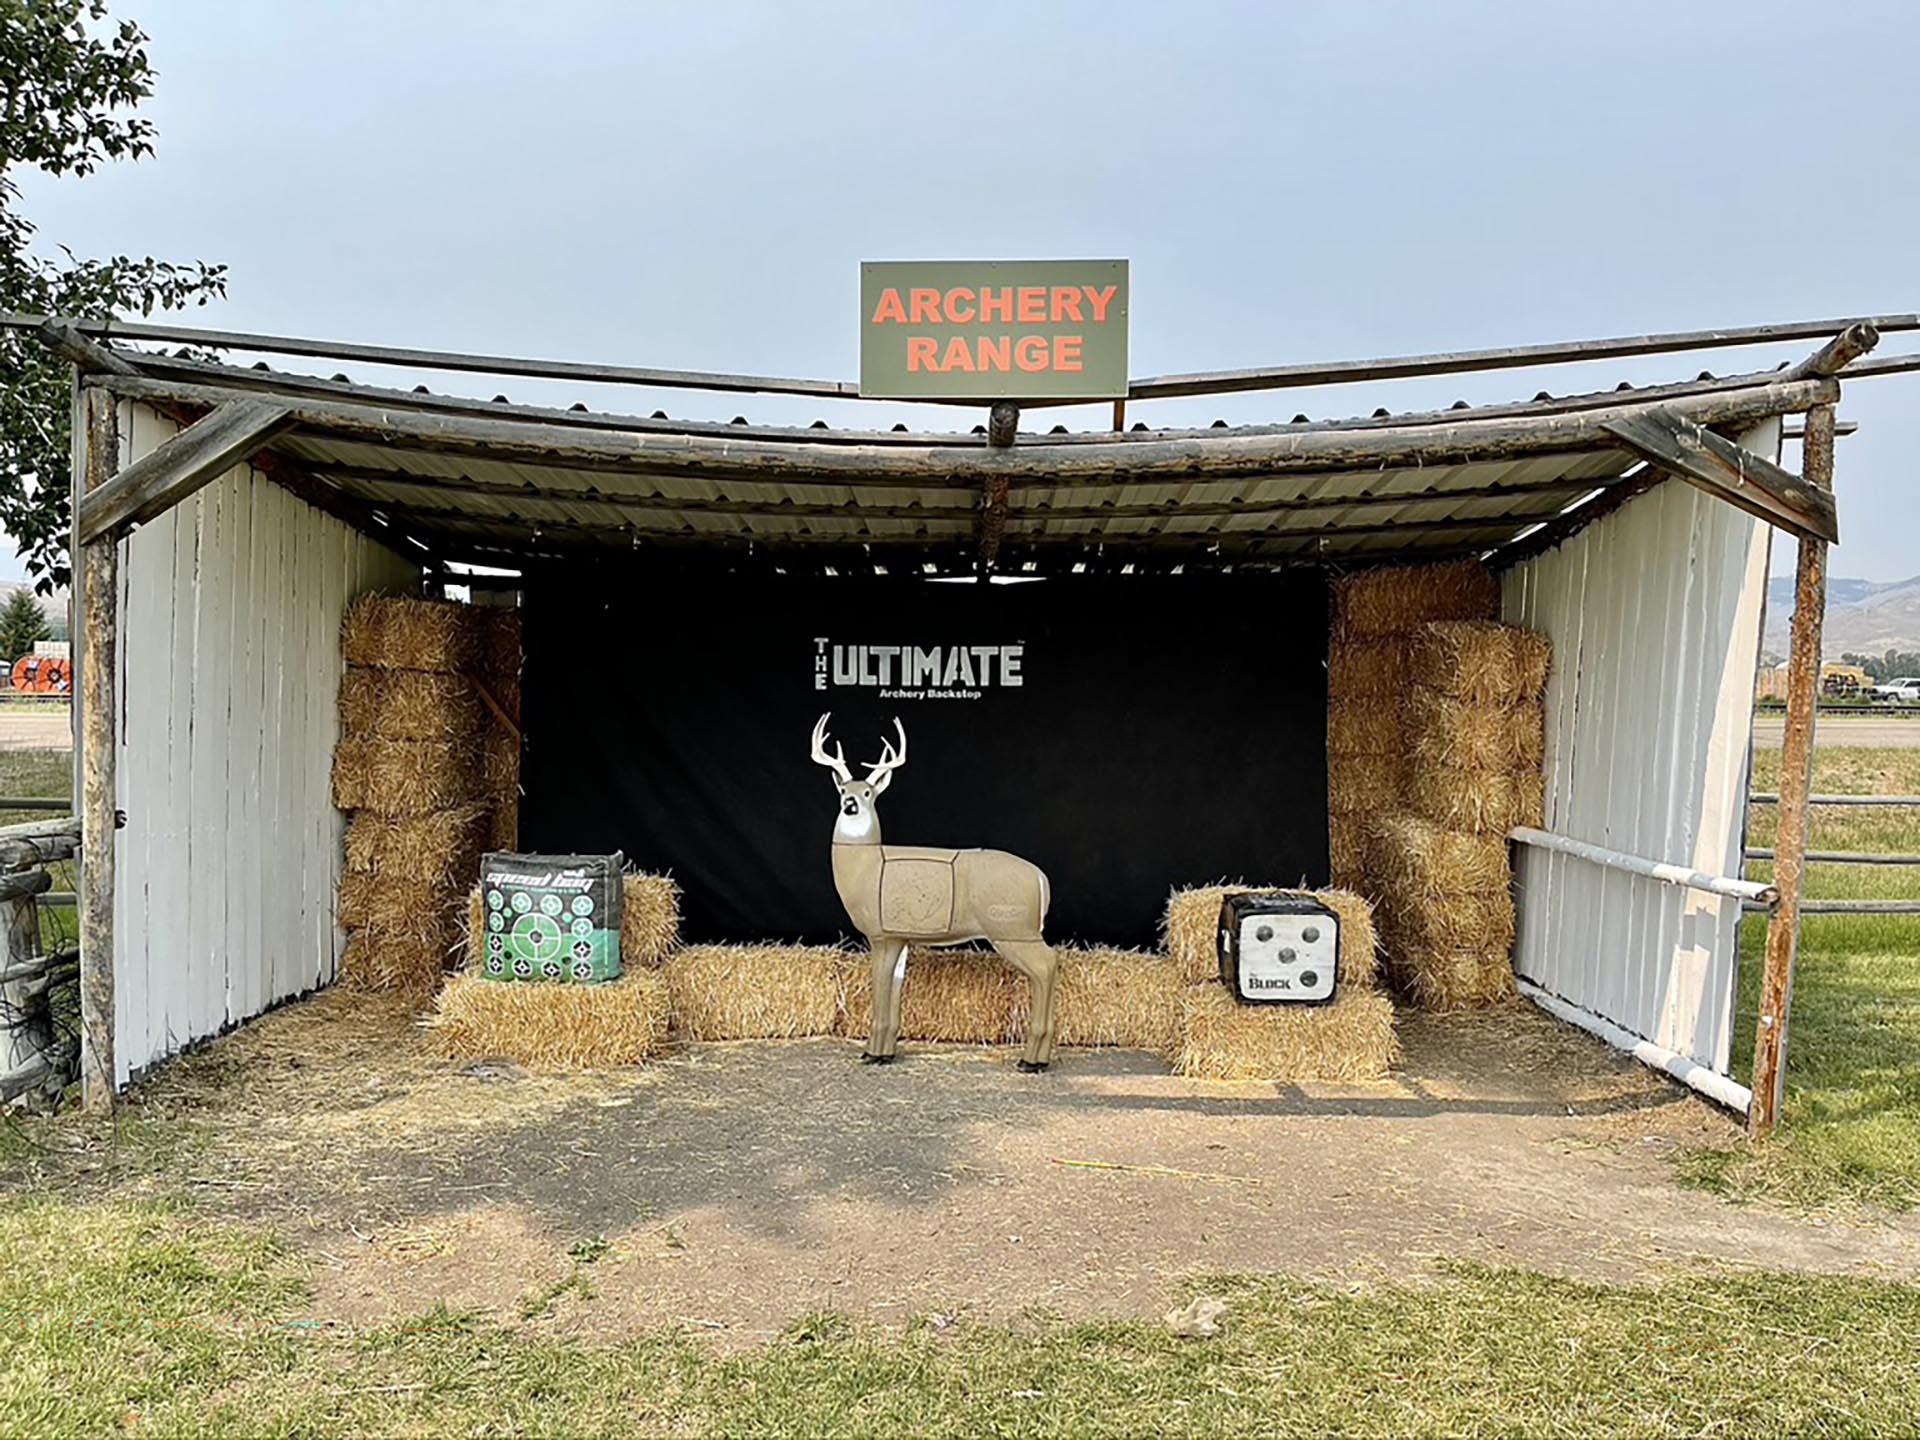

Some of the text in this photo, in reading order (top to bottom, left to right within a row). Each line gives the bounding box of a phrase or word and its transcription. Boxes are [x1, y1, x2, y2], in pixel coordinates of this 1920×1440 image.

[872, 286, 1118, 325] ARCHERY
[906, 336, 1085, 373] RANGE
[814, 637, 830, 691] THE
[833, 644, 1024, 687] ULTIMATE
[879, 688, 982, 700] Archery Backstop
[1249, 978, 1291, 990] BLOCK
